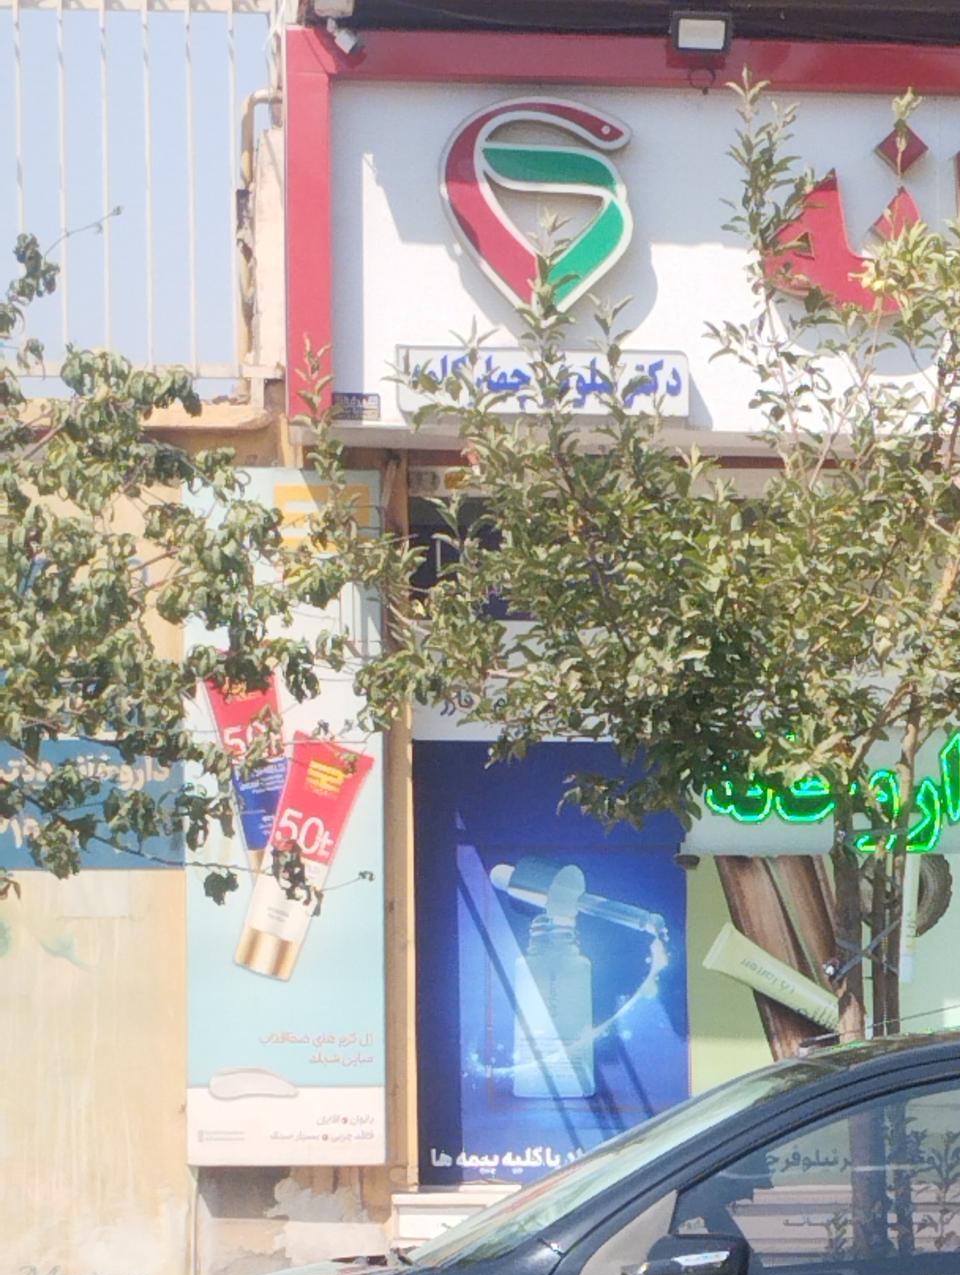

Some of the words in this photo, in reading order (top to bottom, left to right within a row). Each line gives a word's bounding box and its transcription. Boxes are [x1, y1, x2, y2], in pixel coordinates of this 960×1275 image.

[430, 1148, 453, 1168] ها
[456, 1149, 499, 1178] بیمه
[501, 1145, 543, 1175] کلیه
